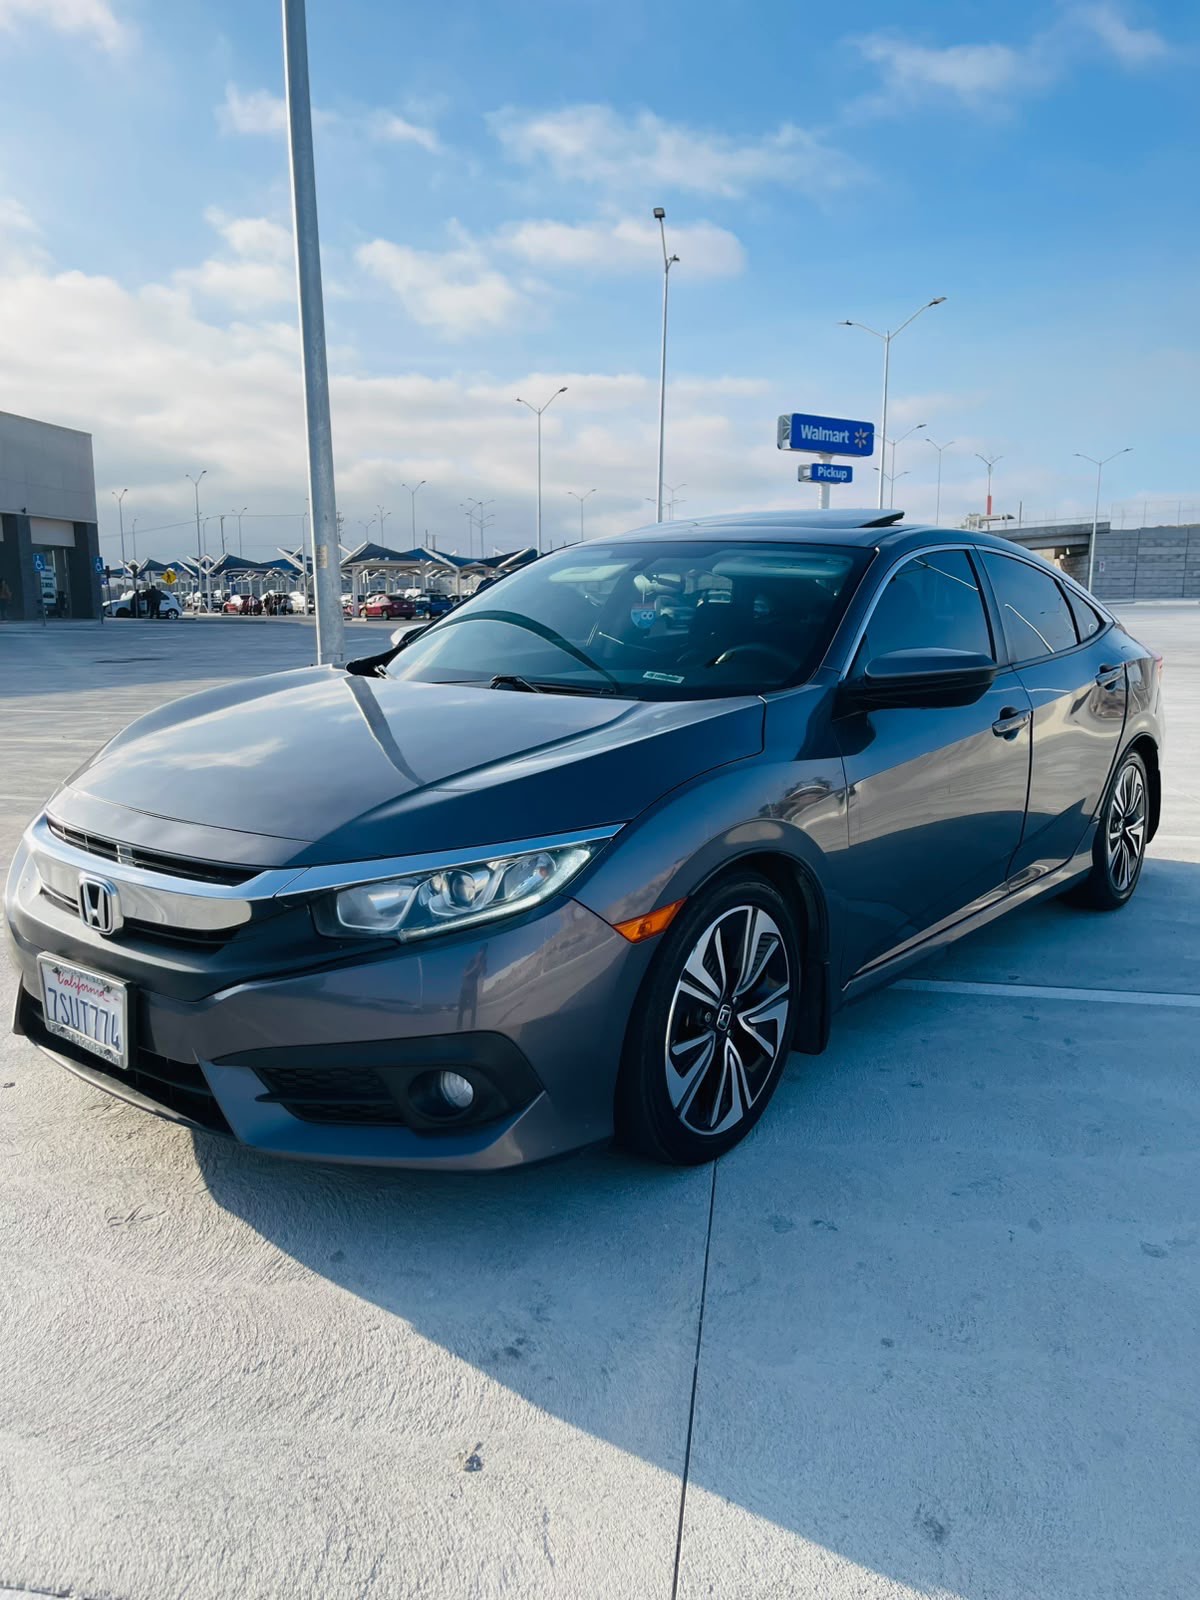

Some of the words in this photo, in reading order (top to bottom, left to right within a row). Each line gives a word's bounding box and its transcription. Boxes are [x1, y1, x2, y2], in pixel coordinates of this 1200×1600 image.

[800, 424, 850, 444] Walmart
[817, 466, 848, 481] Pickup
[56, 971, 109, 1003] California
[47, 986, 121, 1051] 7SUT774
